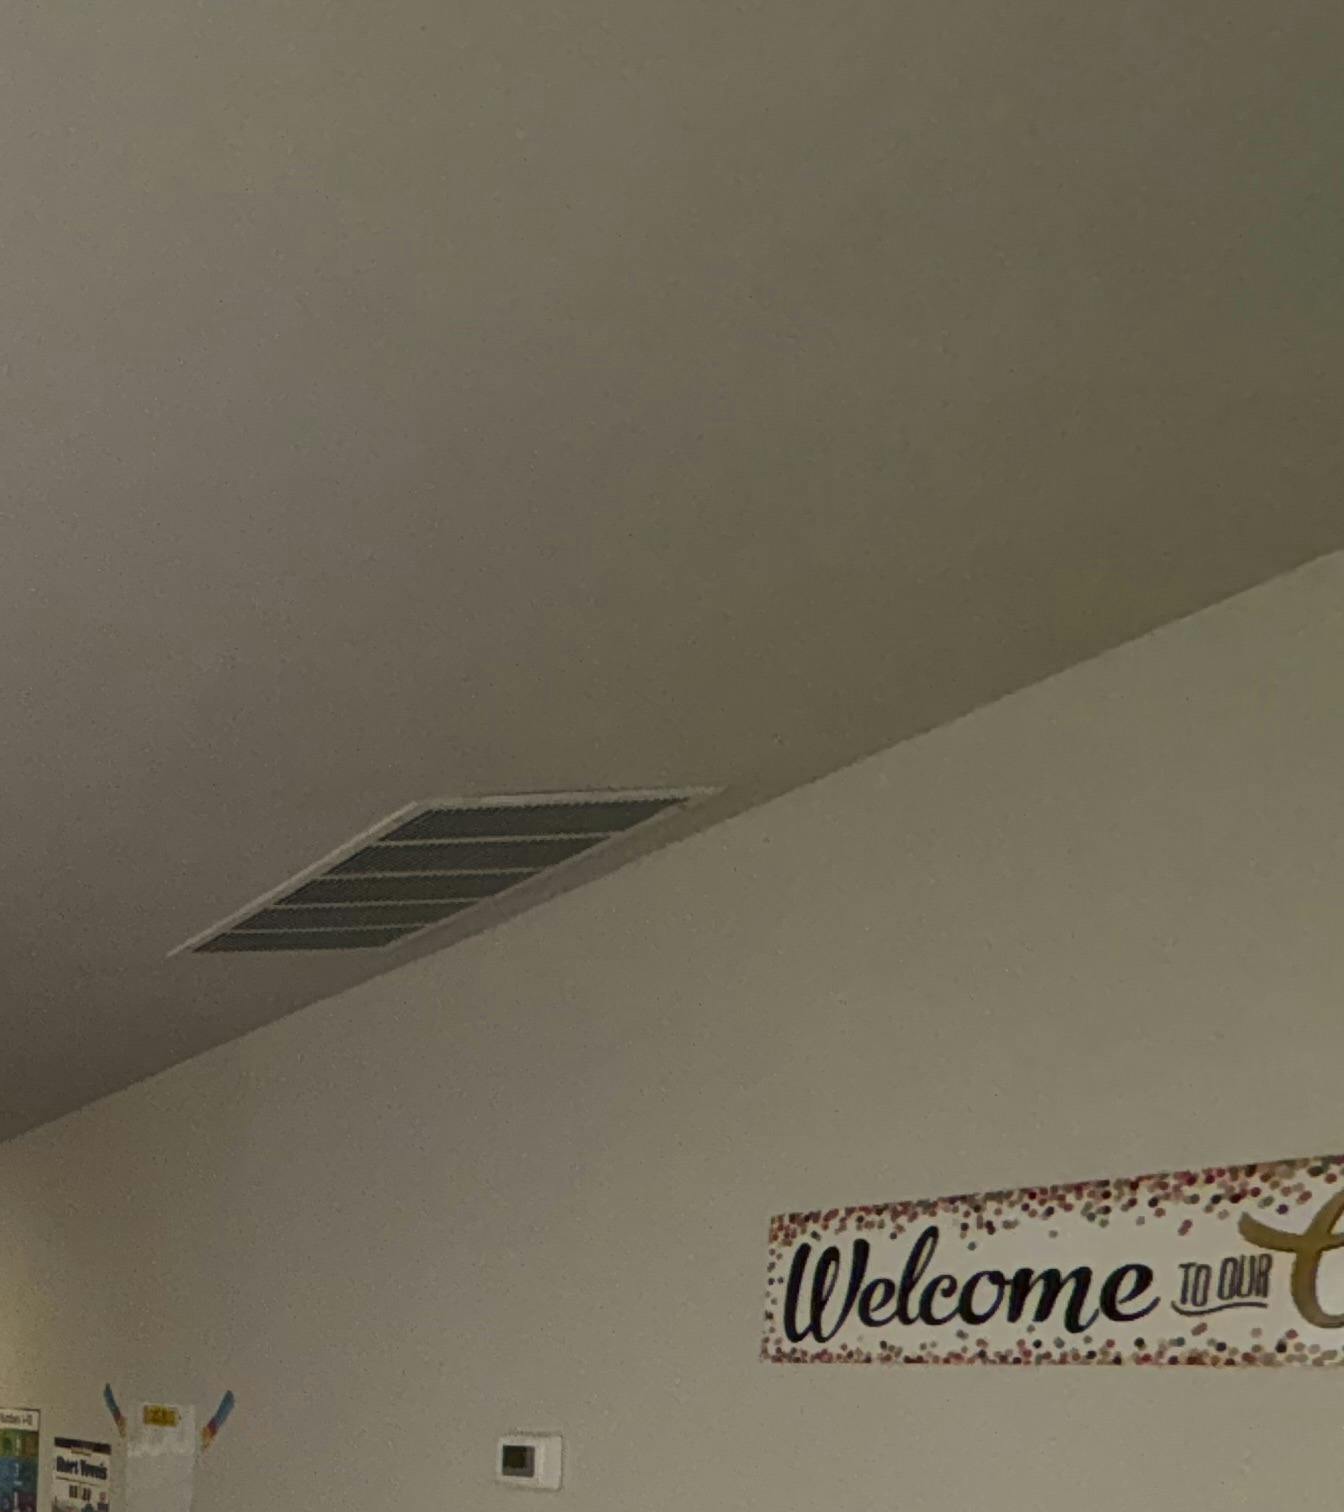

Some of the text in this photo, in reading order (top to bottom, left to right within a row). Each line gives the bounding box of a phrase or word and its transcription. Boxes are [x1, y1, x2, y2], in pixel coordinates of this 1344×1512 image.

[783, 1224, 1273, 1345] Welcome TO OUR
